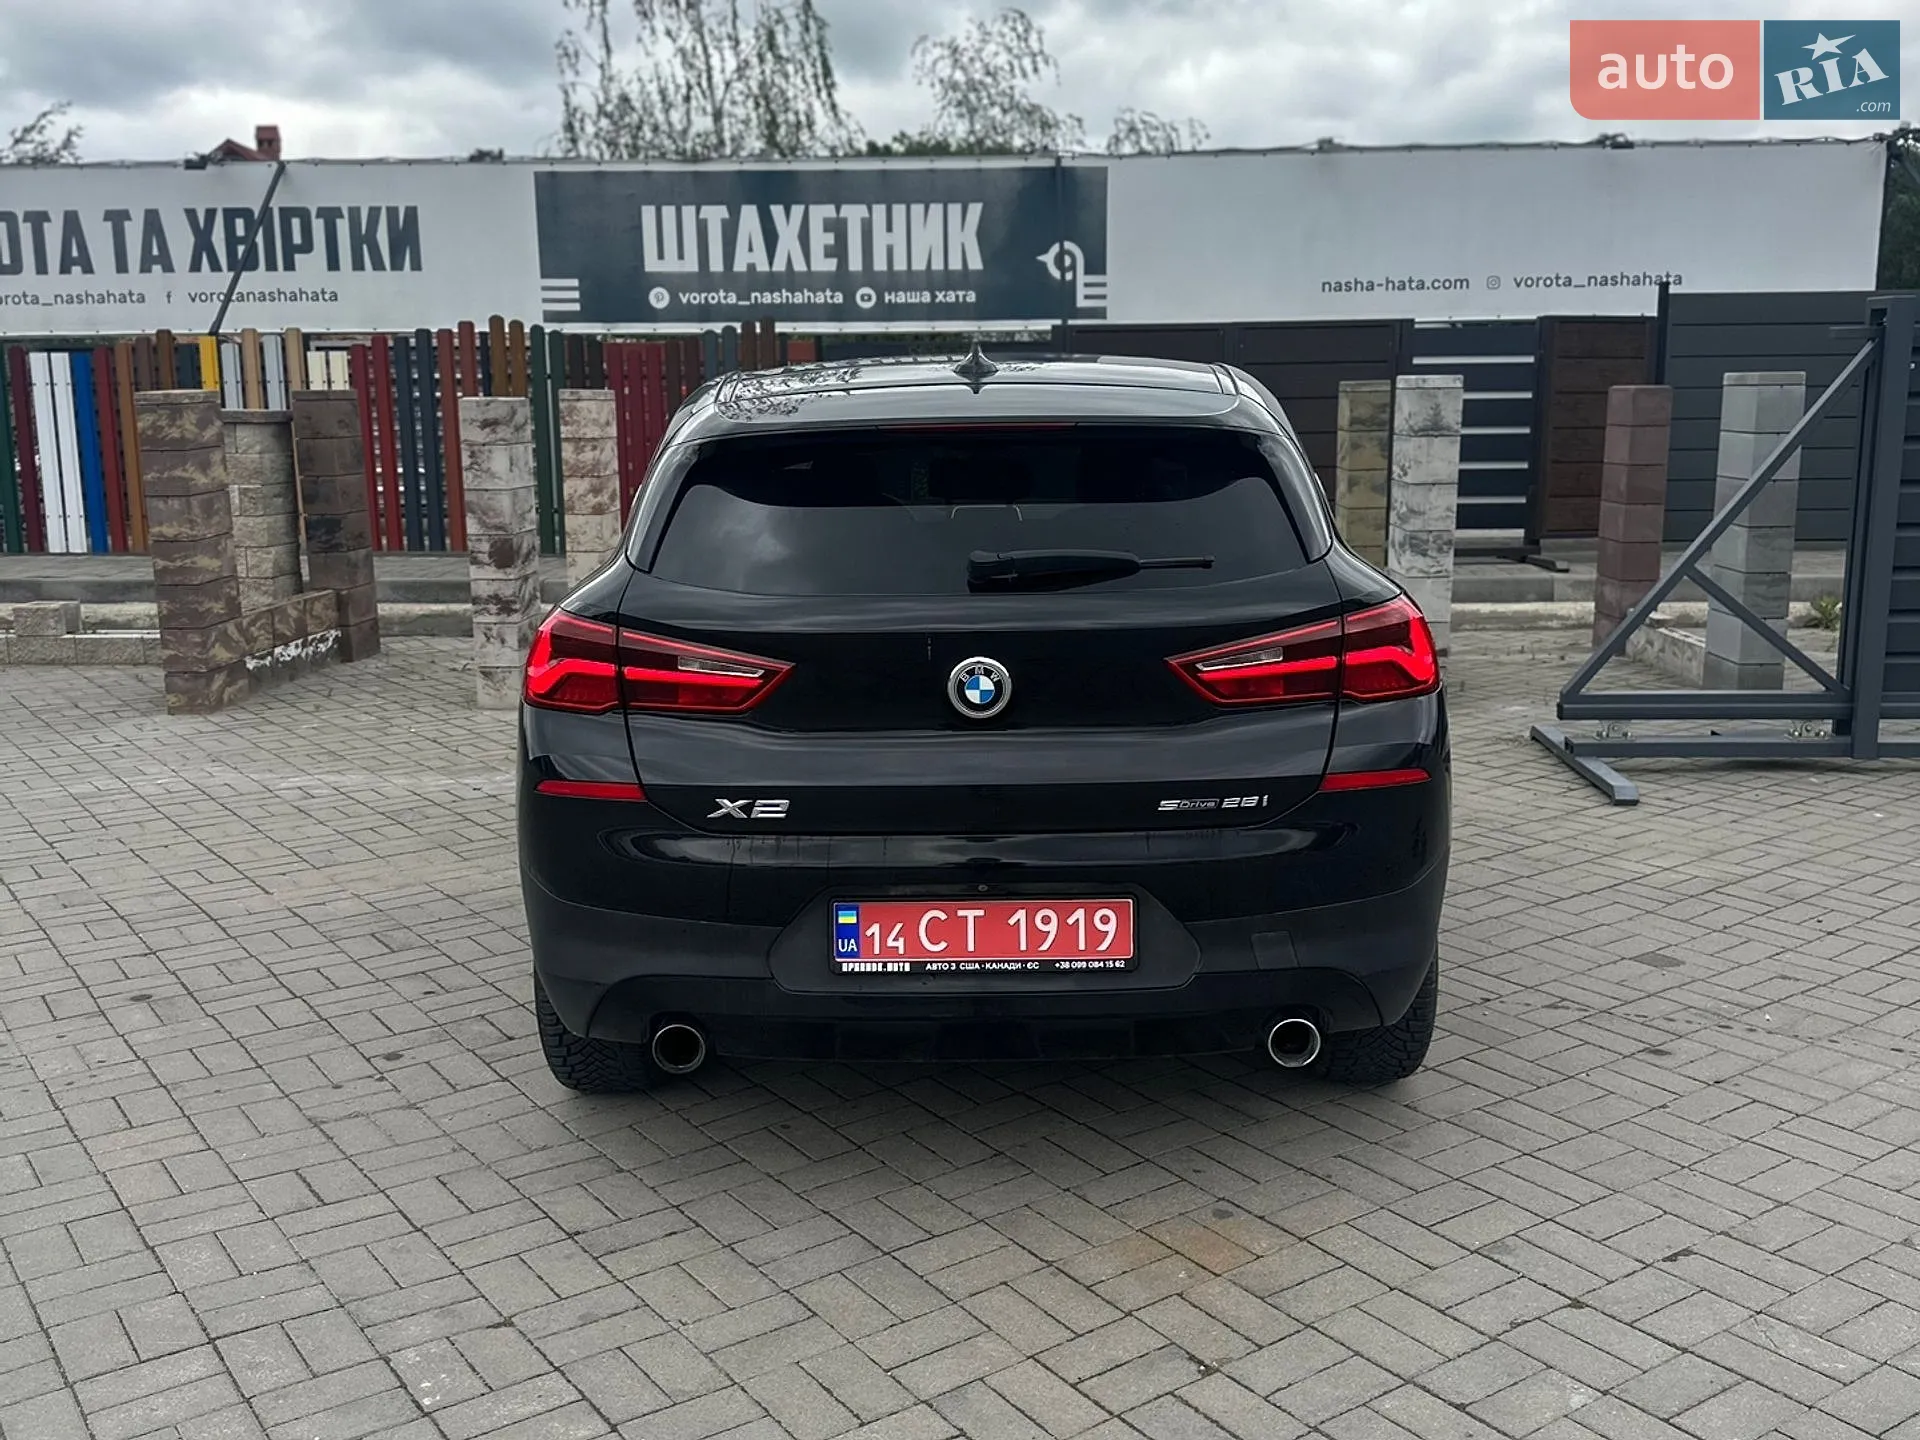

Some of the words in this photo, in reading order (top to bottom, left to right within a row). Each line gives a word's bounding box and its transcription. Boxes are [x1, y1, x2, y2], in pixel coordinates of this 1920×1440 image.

[103, 208, 176, 275] ТА
[183, 205, 423, 273] ХВІРТКИ
[640, 202, 985, 272] ШТАХЕТНИК
[1321, 275, 1470, 294] nasha-hata.com
[678, 287, 844, 307] vorota_nashahata
[884, 291, 931, 305] наша
[935, 290, 976, 304] хата
[959, 664, 1001, 683] BMW
[706, 798, 790, 819] X2
[865, 923, 905, 955] 14
[1007, 907, 1117, 951] 1919
[838, 938, 858, 952] UA
